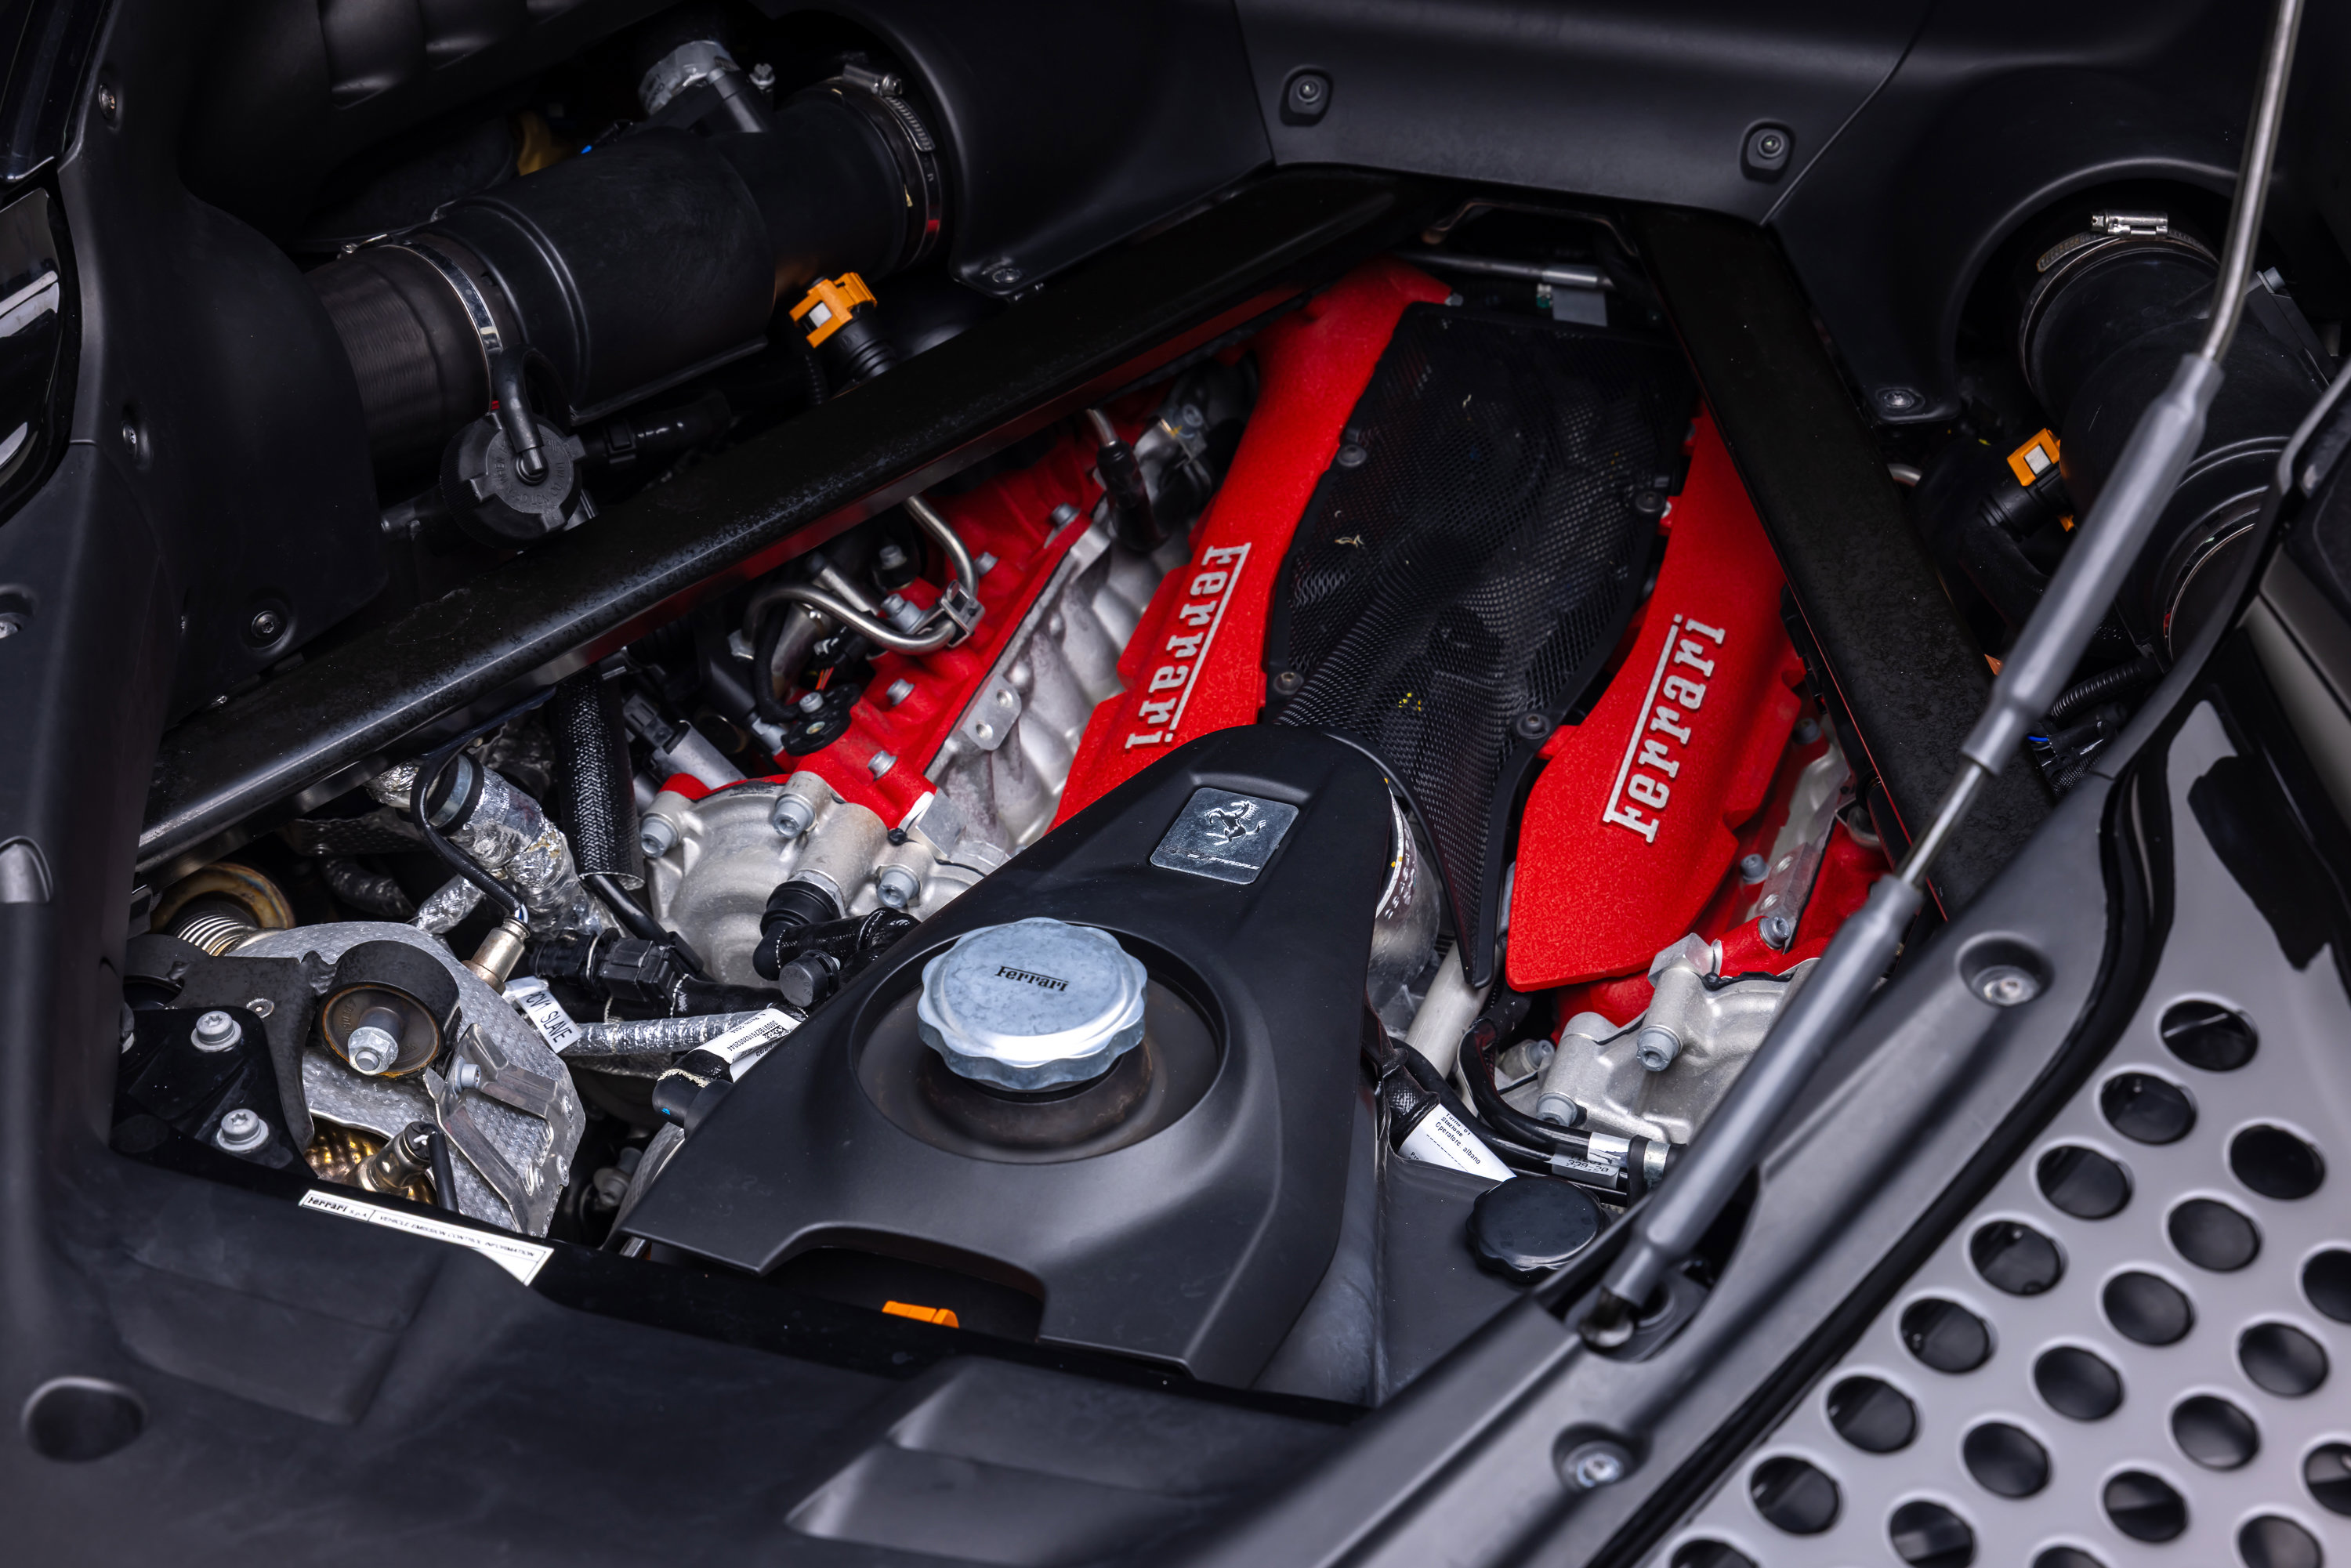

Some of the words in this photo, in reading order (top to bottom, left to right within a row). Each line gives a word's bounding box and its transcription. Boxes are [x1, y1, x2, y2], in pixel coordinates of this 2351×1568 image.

[1125, 542, 1252, 748] Ferrari
[1602, 614, 1726, 843] Ferrari
[994, 965, 1069, 992] Ferrari
[540, 1011, 573, 1043] SLAVE
[1440, 1117, 1463, 1137] Stazione
[1462, 1146, 1481, 1164] albano
